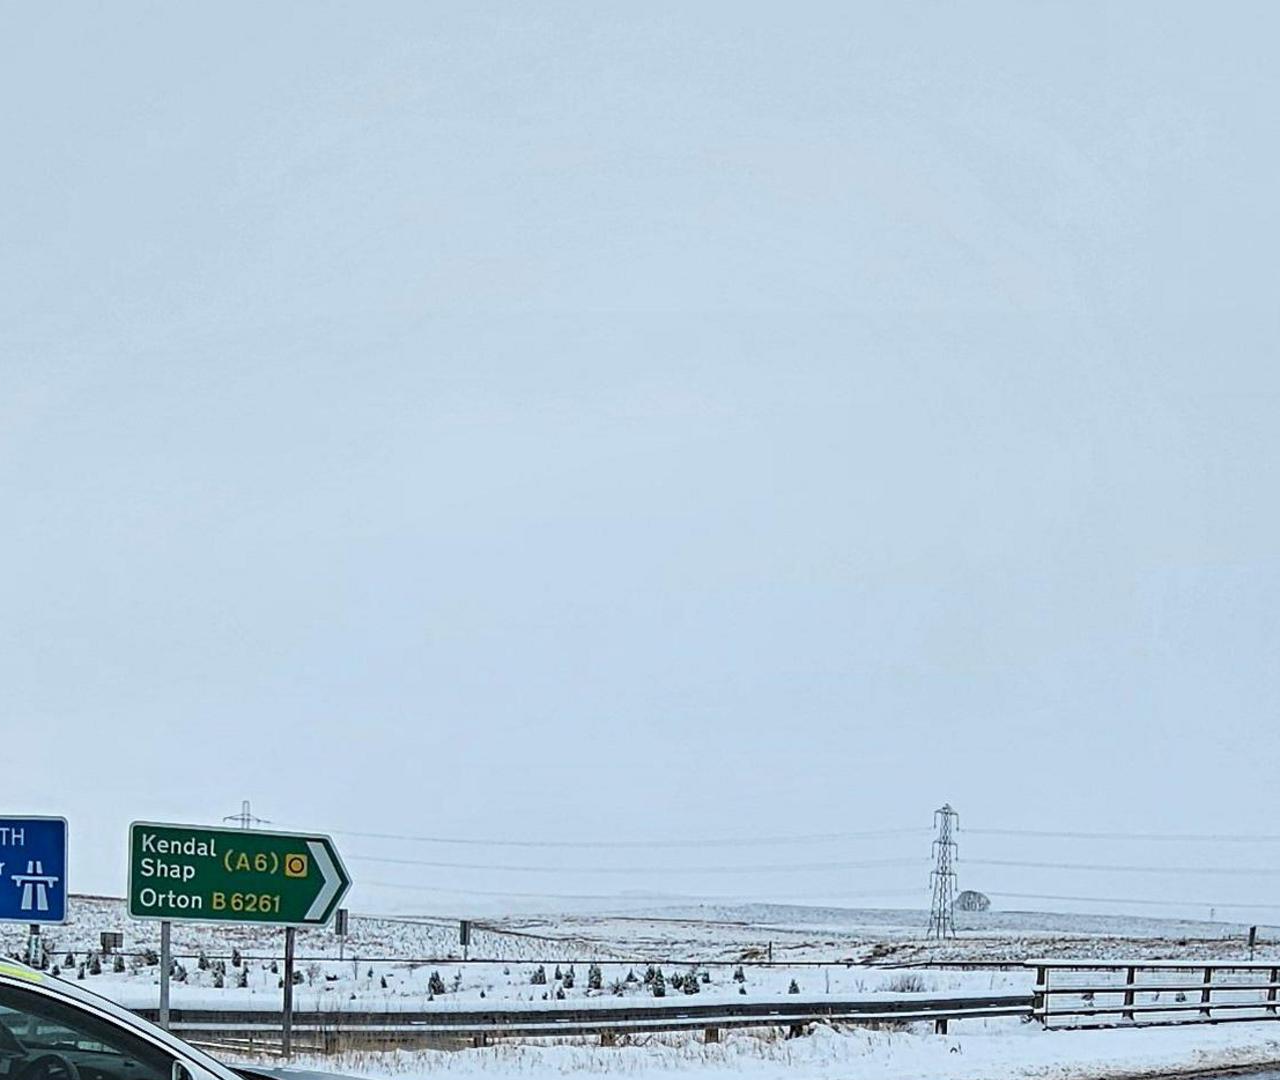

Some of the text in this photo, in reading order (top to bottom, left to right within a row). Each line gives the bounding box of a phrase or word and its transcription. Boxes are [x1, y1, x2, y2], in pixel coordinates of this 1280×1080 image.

[141, 833, 217, 857] Kendal
[140, 858, 196, 882] Shap
[140, 888, 203, 909] Orton
